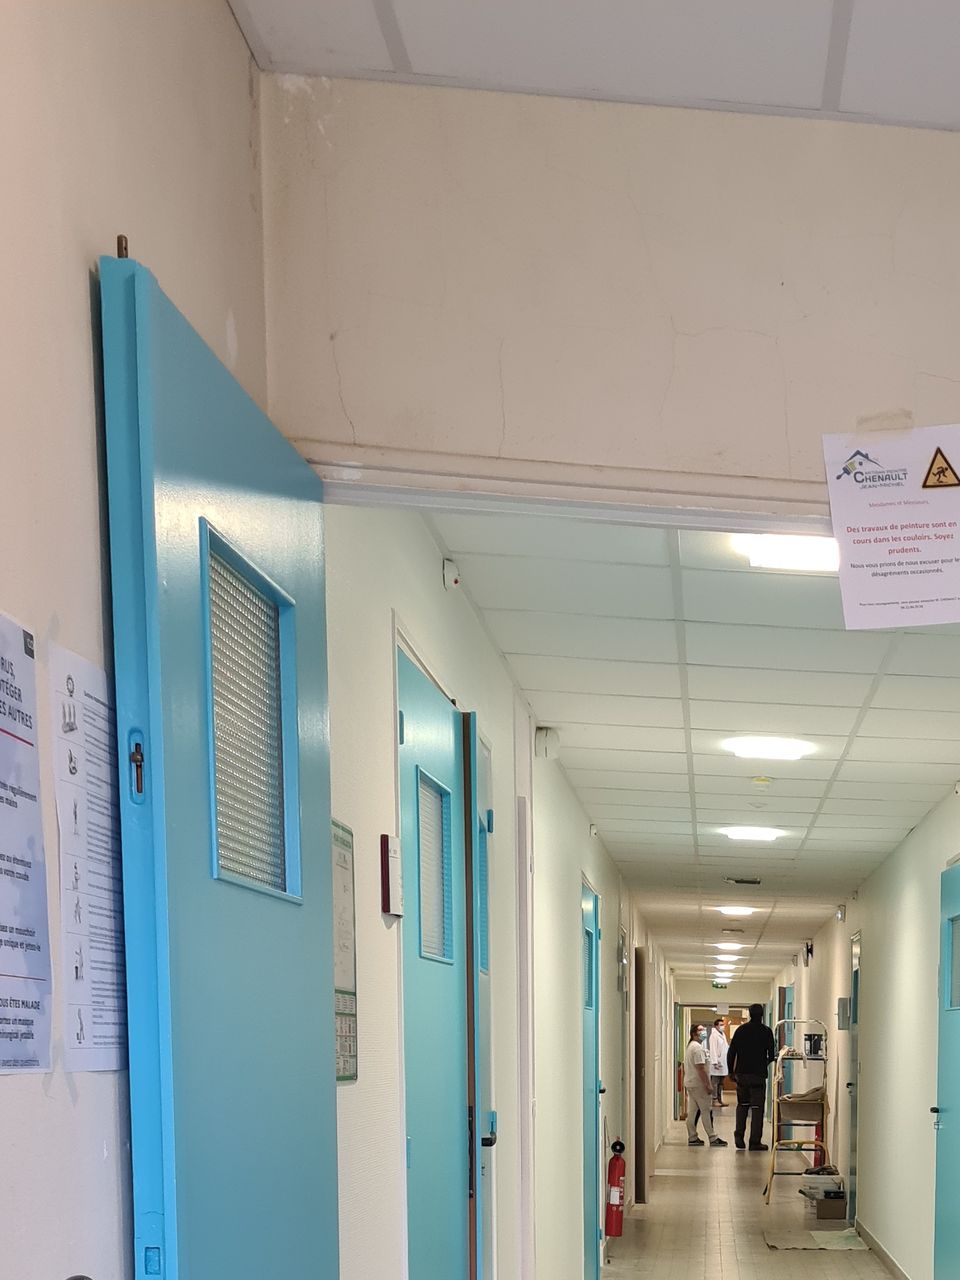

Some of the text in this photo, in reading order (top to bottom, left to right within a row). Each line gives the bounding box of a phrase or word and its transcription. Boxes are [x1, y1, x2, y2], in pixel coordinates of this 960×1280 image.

[853, 471, 908, 483] CHENAULT
[861, 525, 888, 533] travaux
[900, 522, 930, 531] peinture
[873, 536, 891, 544] dans
[934, 533, 954, 541] Soyez
[888, 546, 922, 555] prudents.
[879, 561, 896, 569] prions
[9, 996, 20, 1009] ÊTES
[21, 999, 40, 1010] MALADE
